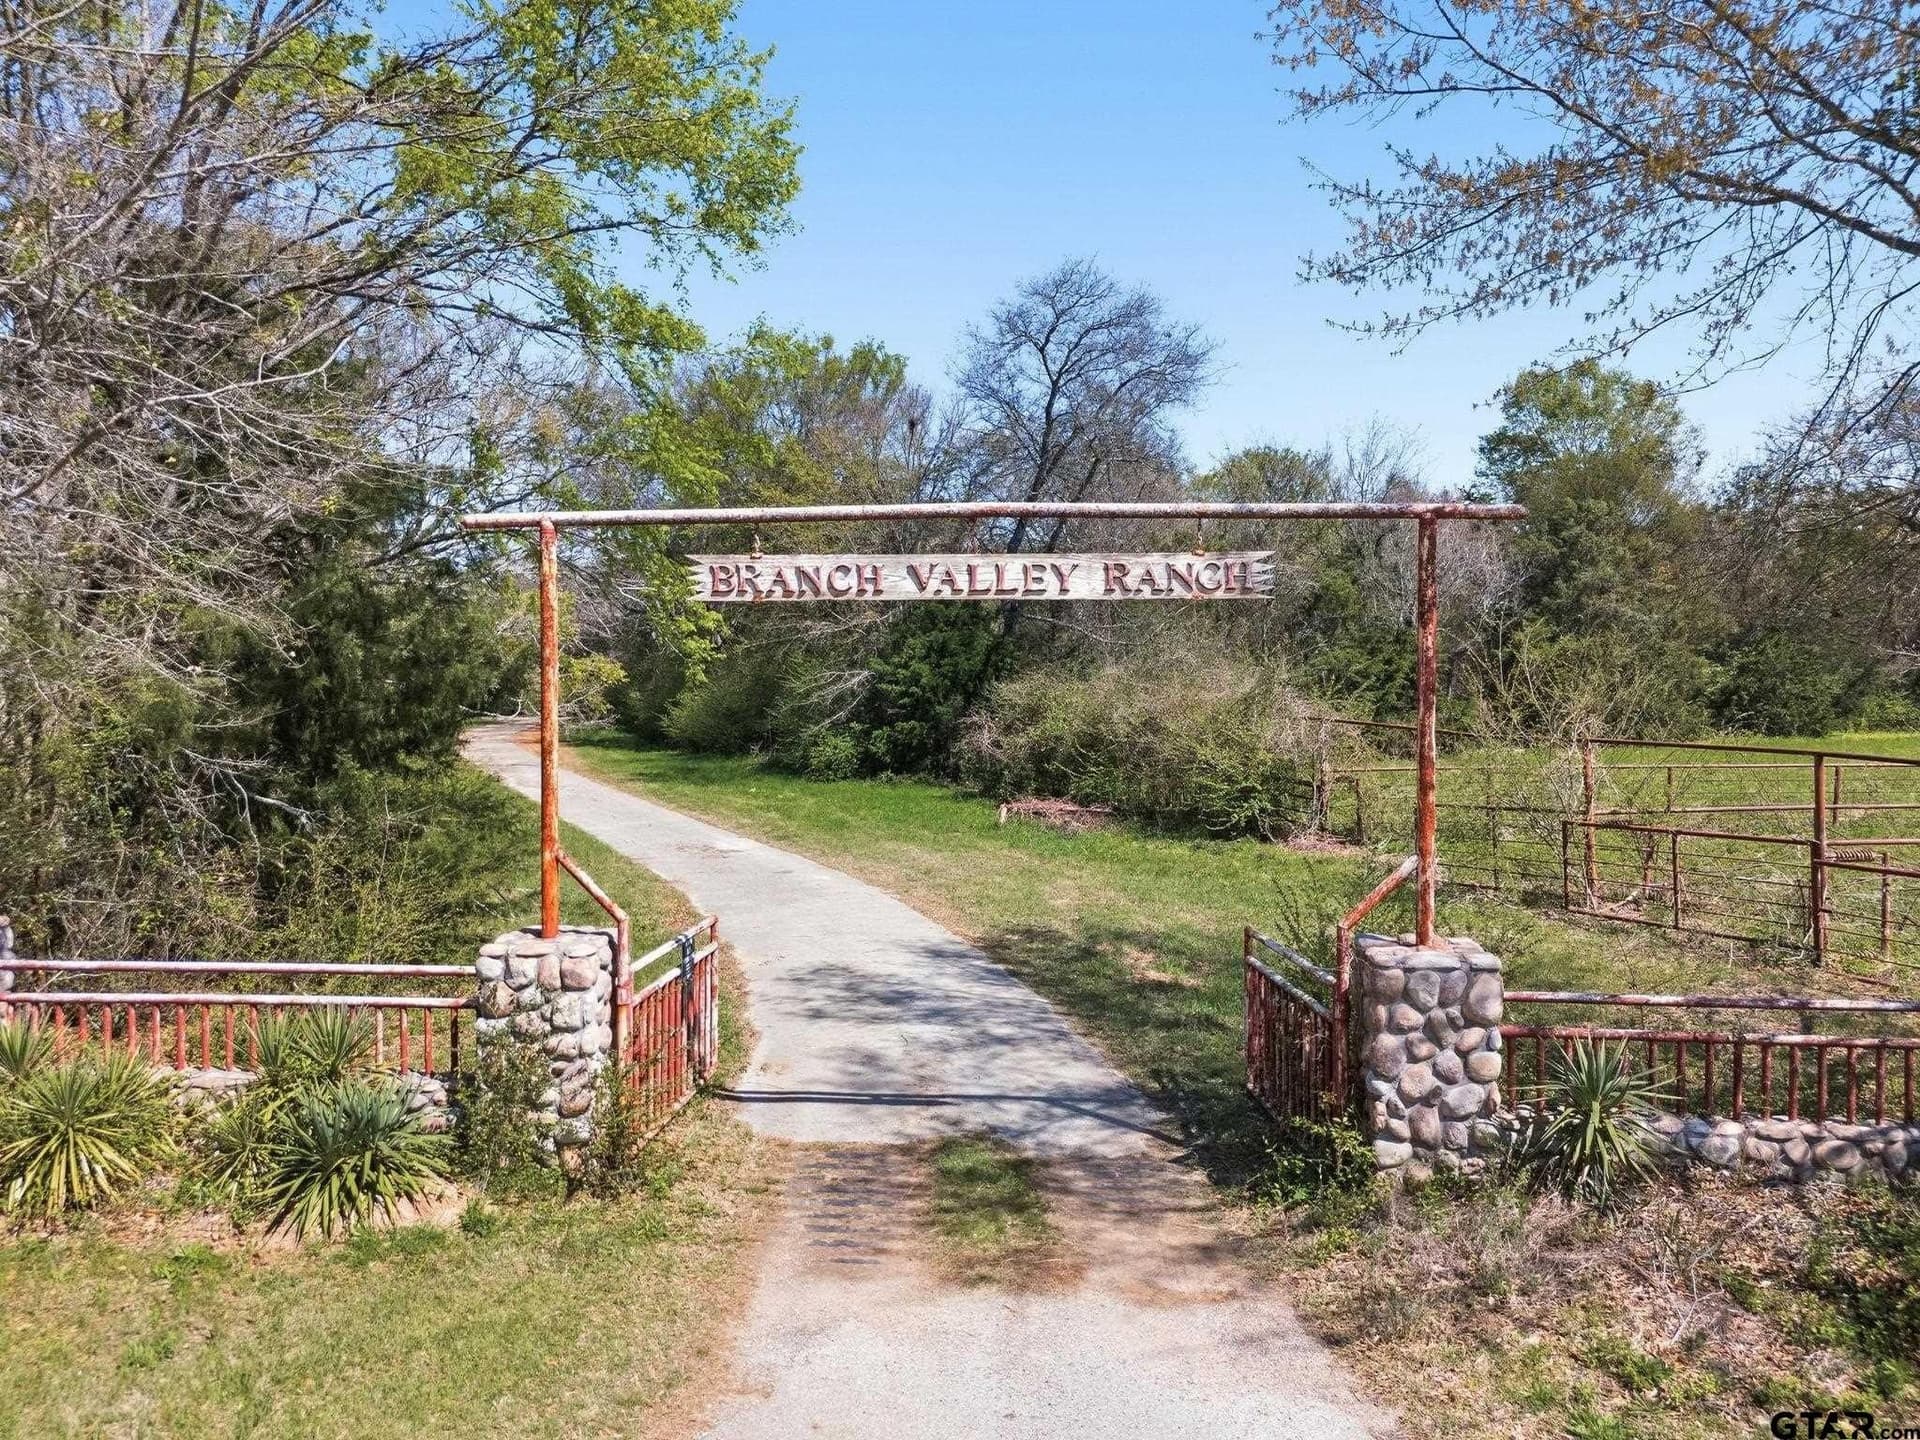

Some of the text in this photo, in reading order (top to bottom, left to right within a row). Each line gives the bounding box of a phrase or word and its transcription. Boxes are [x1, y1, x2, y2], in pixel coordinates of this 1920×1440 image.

[709, 561, 1255, 598] BRANCH VALLEY RANCH
